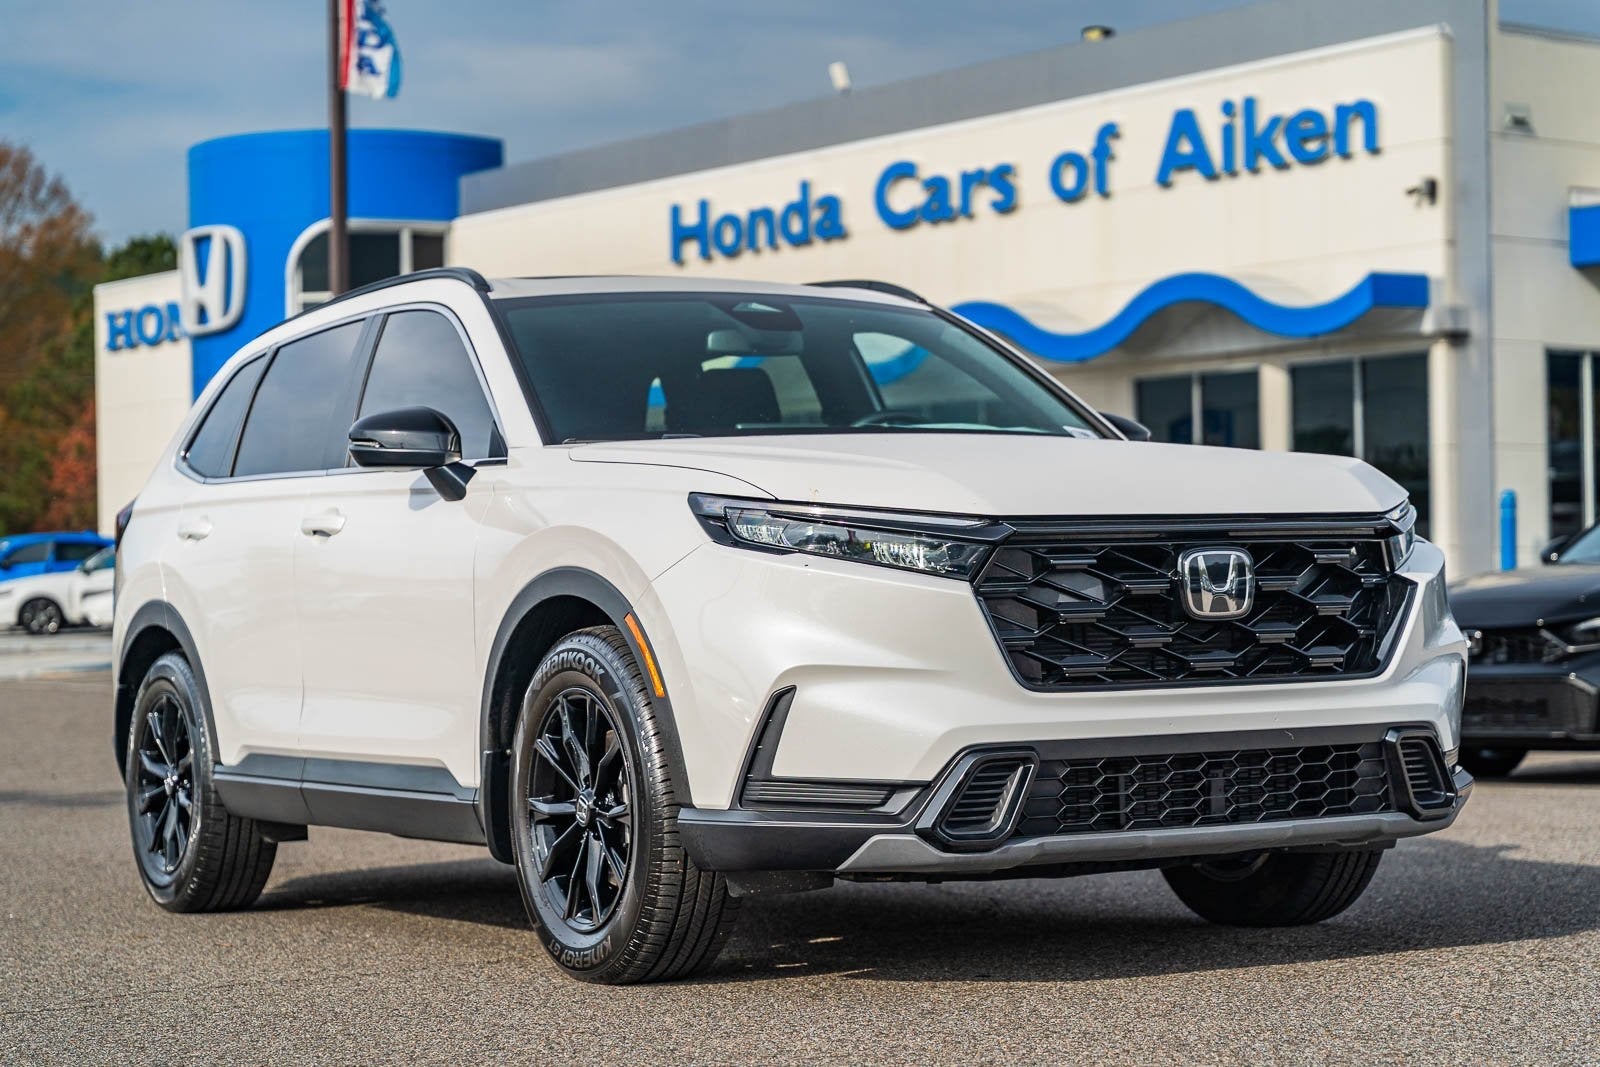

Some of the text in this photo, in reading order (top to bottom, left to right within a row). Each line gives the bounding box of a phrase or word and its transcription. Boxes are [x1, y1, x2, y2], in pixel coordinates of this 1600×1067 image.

[670, 96, 1380, 265] Honda Cars of Aiken
